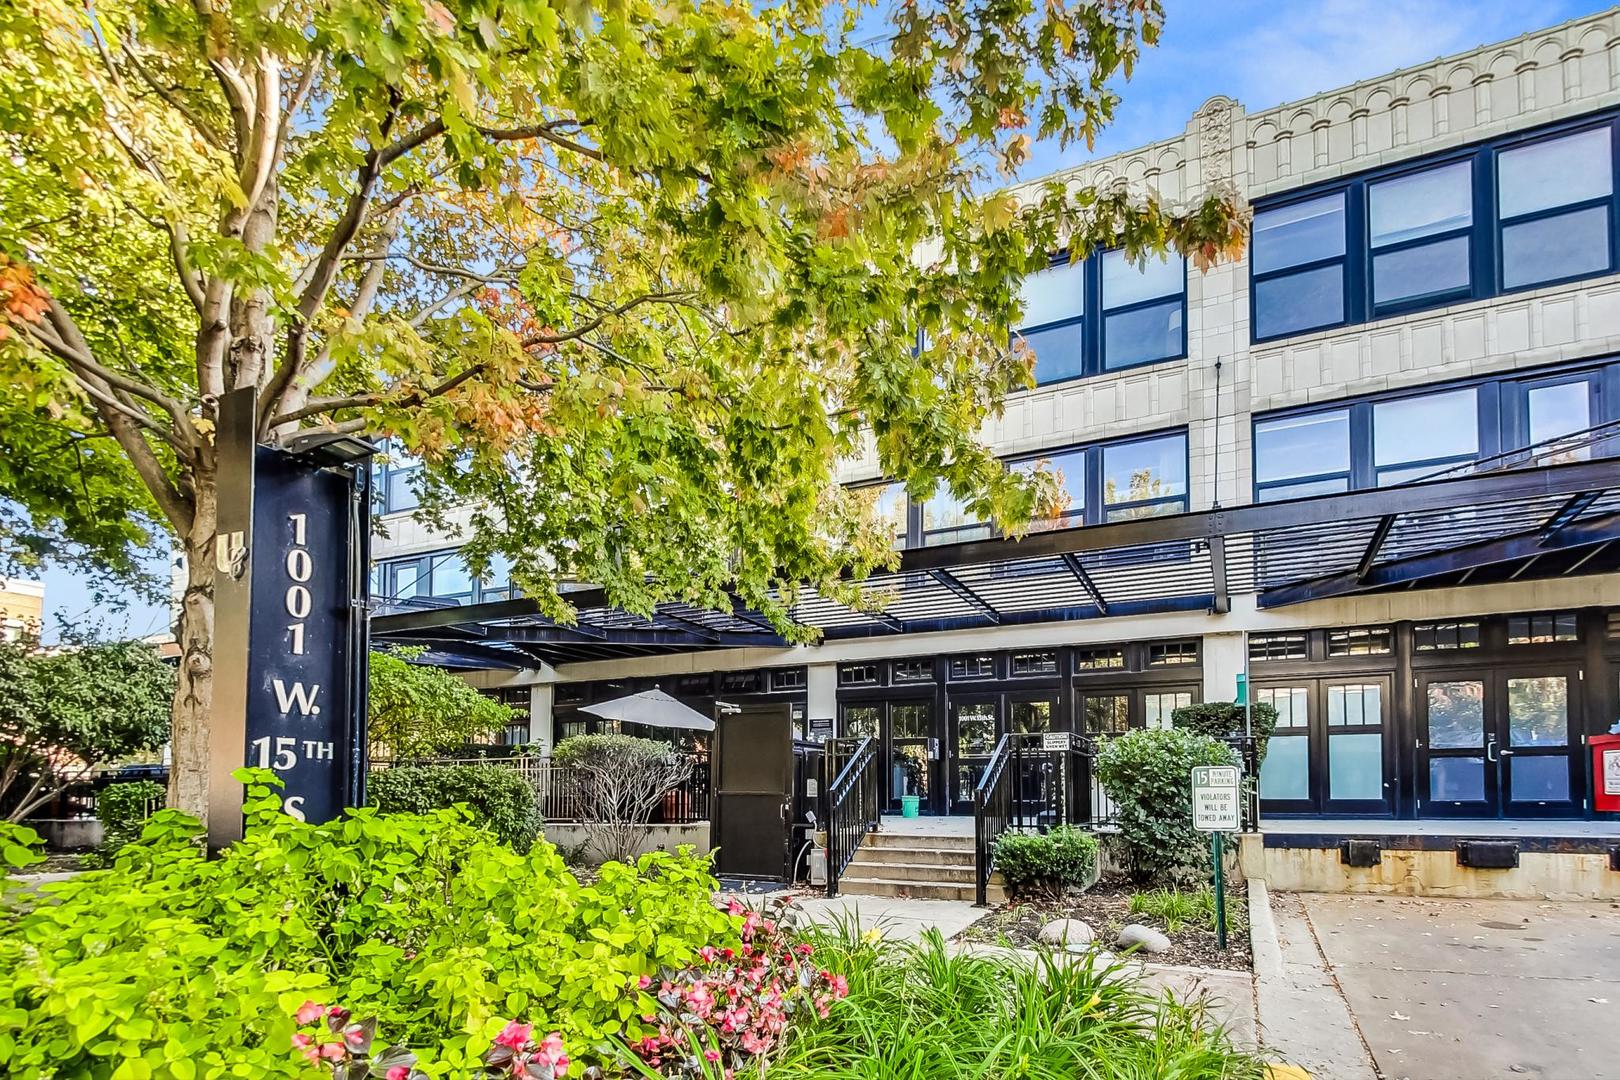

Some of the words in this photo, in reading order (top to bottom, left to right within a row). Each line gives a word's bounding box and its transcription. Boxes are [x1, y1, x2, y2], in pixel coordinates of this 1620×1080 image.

[285, 513, 313, 655] 1001
[273, 679, 321, 715] W.
[1196, 771, 1208, 785] 15
[1211, 777, 1234, 785] PARKING
[1200, 793, 1232, 801] VIOLATORS
[1220, 803, 1228, 811] BE
[1198, 814, 1217, 822] TOWED
[1219, 814, 1235, 822] AWAY
